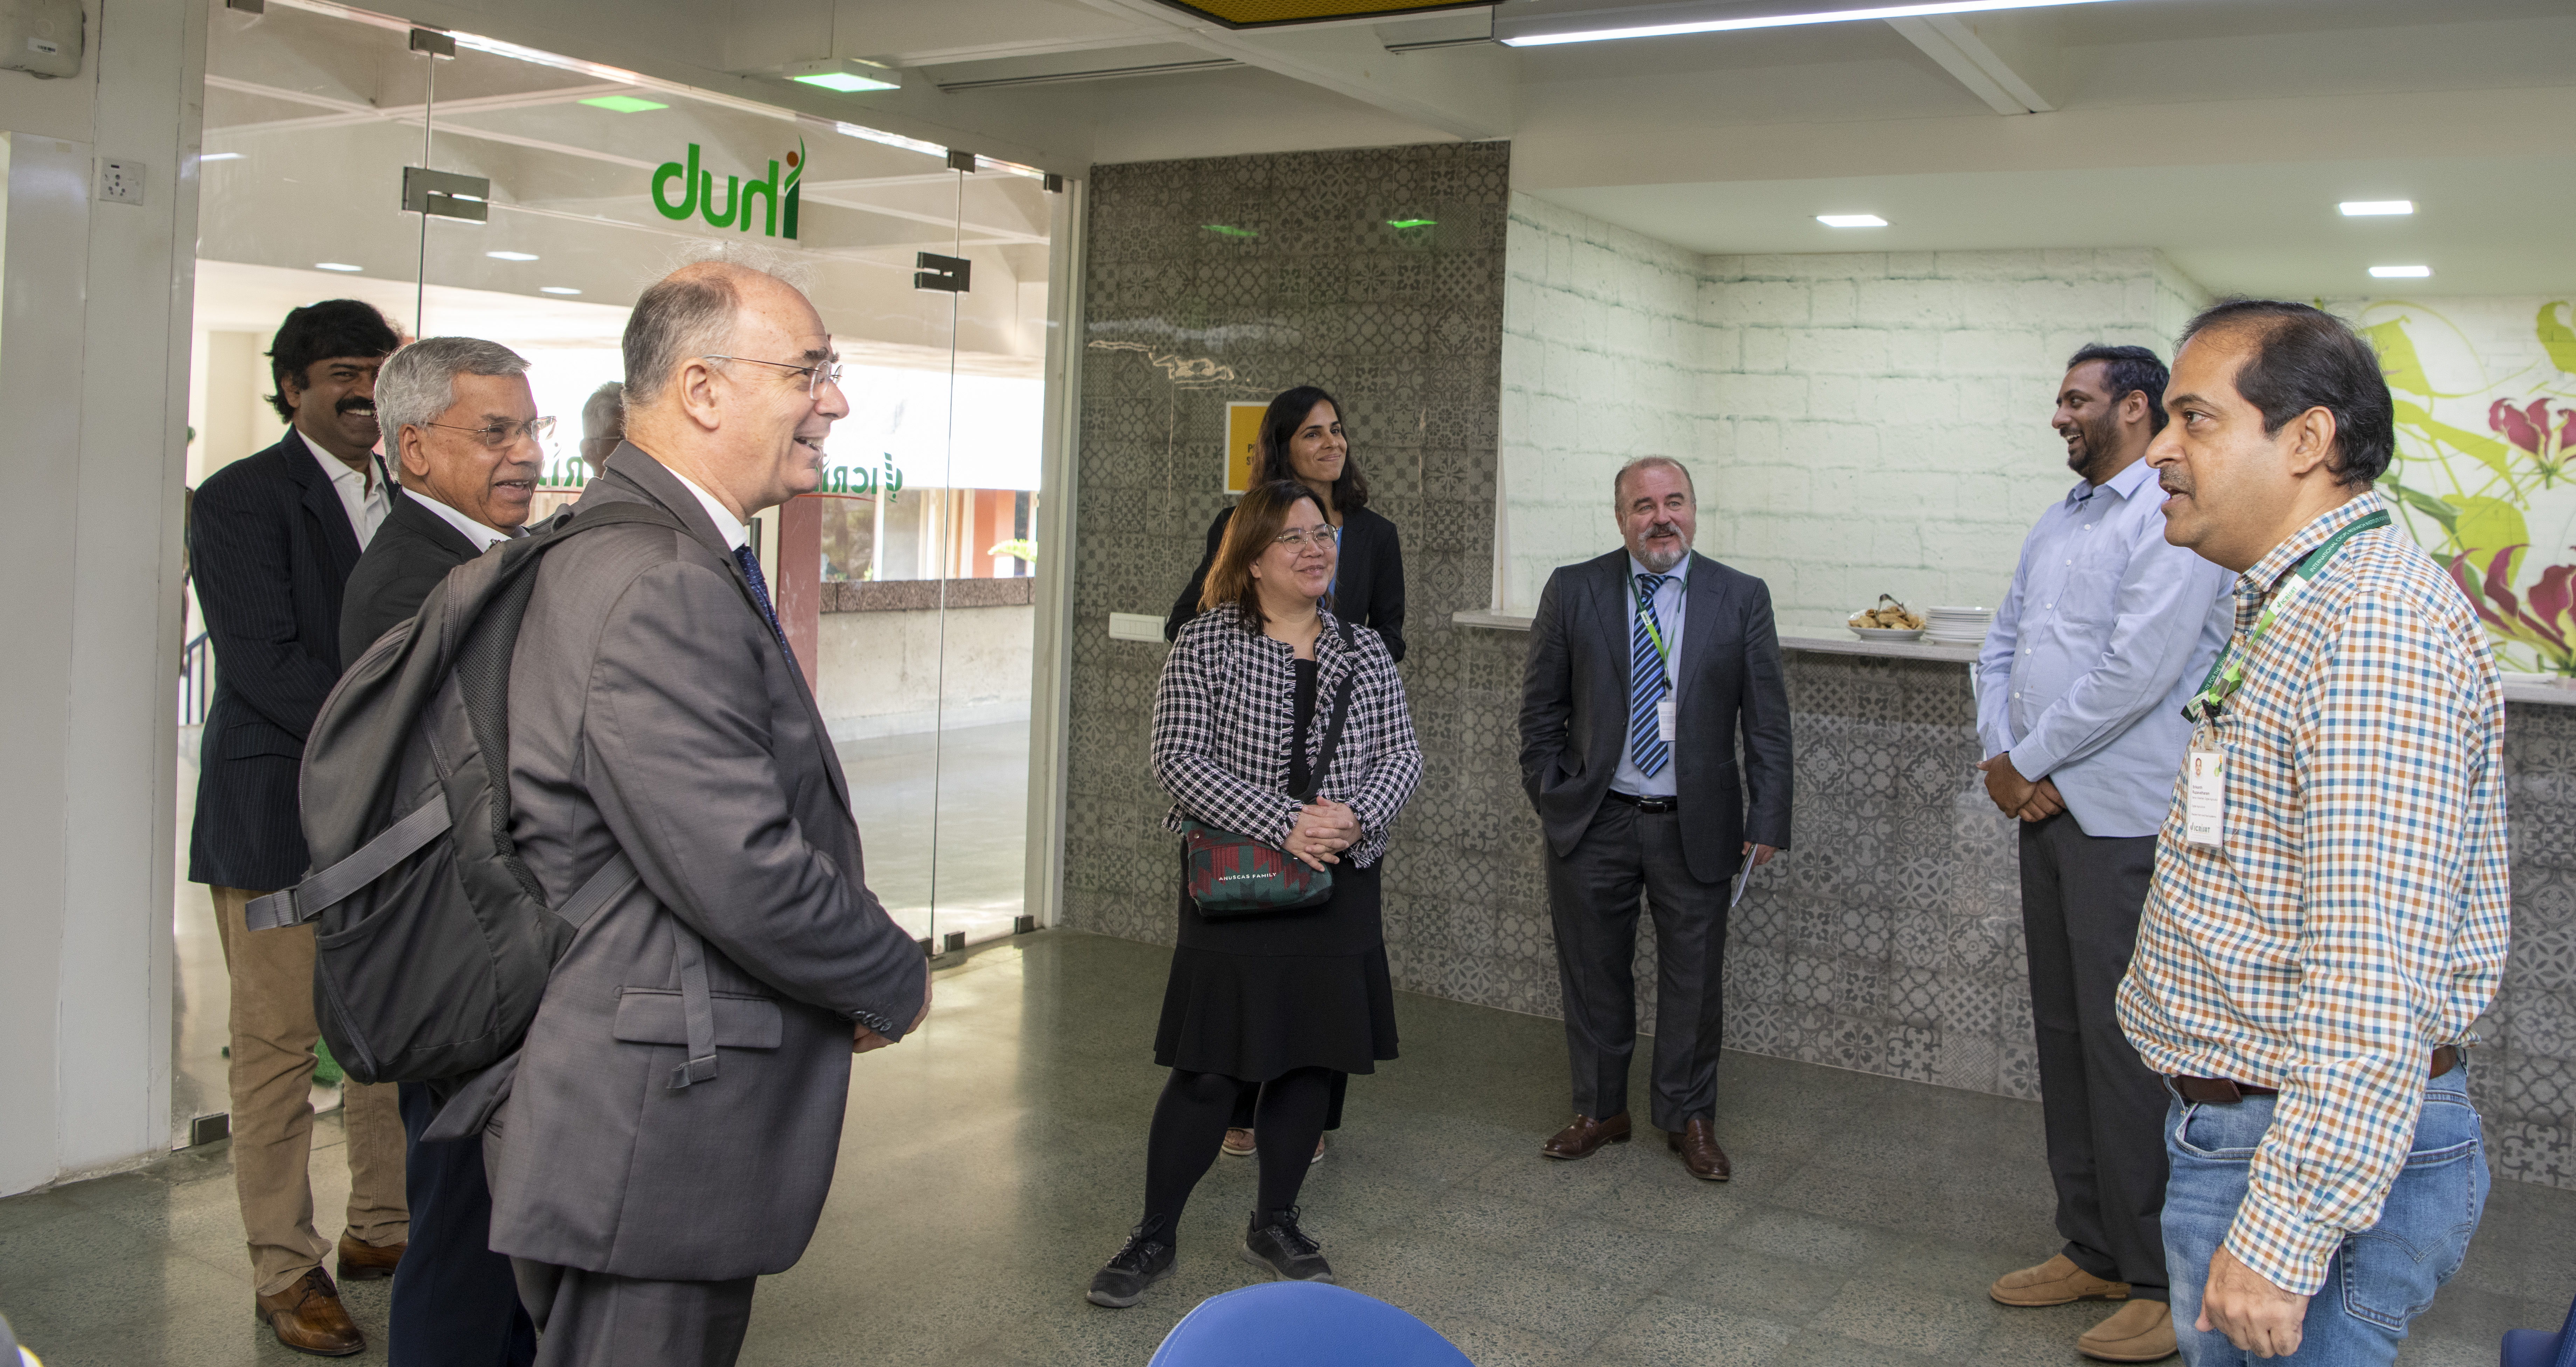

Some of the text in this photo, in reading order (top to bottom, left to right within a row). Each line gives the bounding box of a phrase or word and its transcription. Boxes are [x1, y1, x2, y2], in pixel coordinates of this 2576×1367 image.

[2309, 542, 2338, 572] INTERNATIONAL
[2335, 531, 2349, 542] CROPS
[2347, 522, 2366, 533] RESEARCH
[2365, 518, 2380, 526] INSTITUTE
